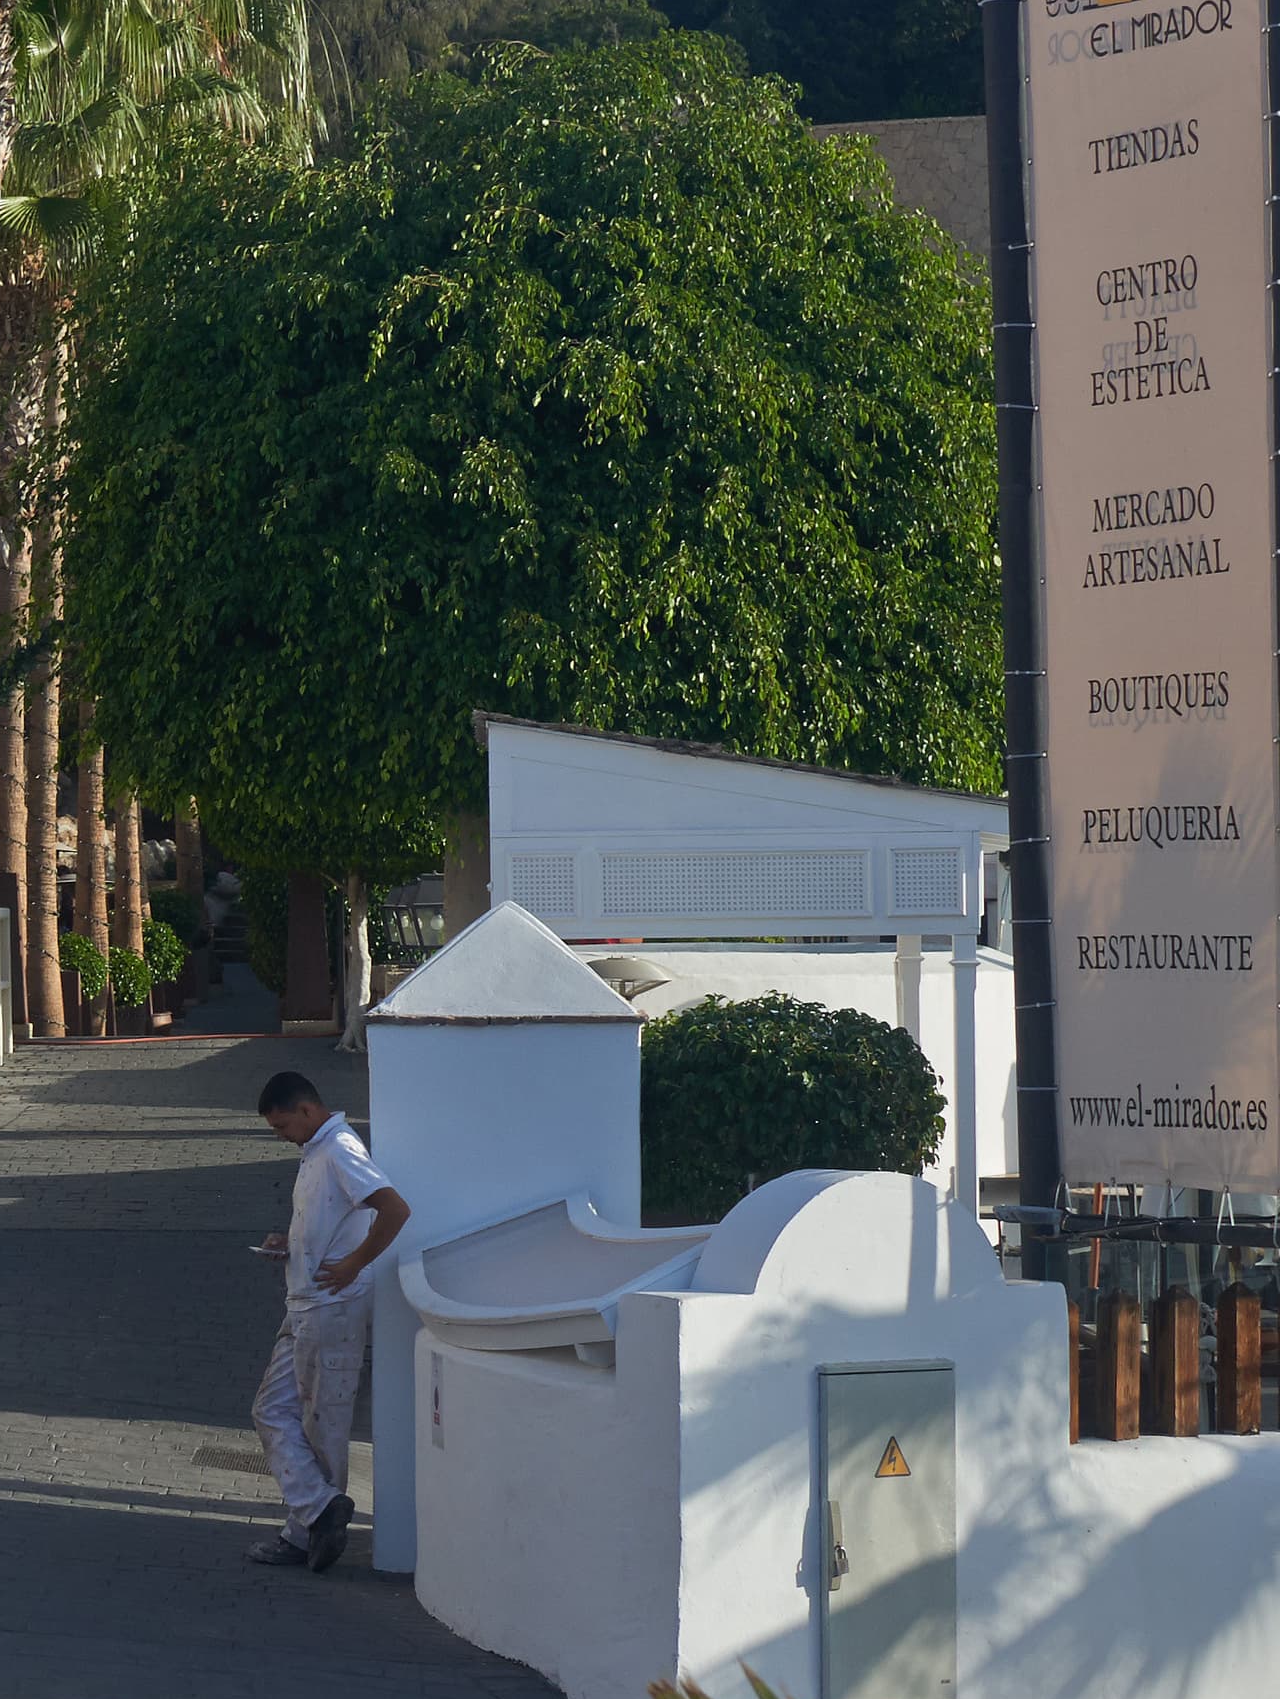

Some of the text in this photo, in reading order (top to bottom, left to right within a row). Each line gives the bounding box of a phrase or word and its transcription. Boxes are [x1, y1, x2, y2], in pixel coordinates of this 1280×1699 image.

[1090, 21, 1123, 57] EL
[1088, 118, 1200, 175] TIENDAS
[1096, 254, 1198, 306] CENTRO
[1134, 316, 1169, 356] DE
[1090, 356, 1211, 407] ESTETICA
[1092, 482, 1215, 533] MERCADO
[1082, 538, 1230, 589] ARTESANAL
[1087, 670, 1230, 717] BOUTIQUES
[1082, 804, 1241, 850] PELUQUERIA
[1076, 934, 1254, 972] RESTAURANTE
[1069, 1082, 1268, 1132] www.el-mirador.es
